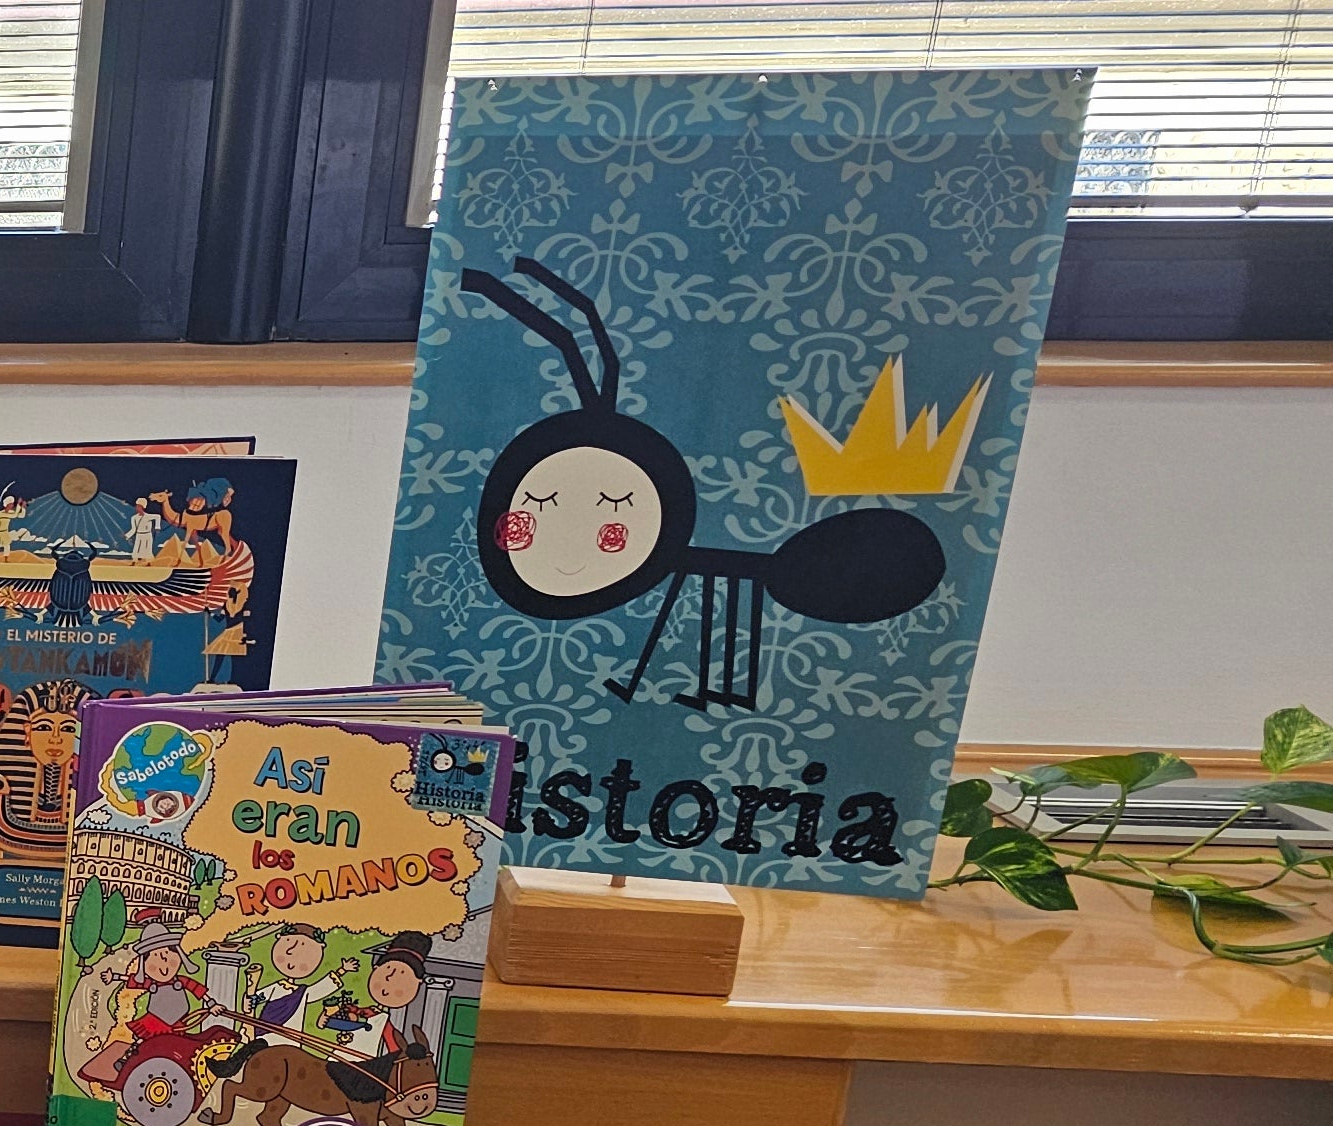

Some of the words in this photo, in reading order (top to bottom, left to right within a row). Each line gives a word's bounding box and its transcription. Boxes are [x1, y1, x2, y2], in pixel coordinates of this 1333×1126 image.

[6, 629, 21, 641] EL
[25, 629, 94, 645] MISTERIO
[97, 632, 117, 645] DE
[115, 740, 198, 785] Sabelotodo
[253, 746, 330, 796] Así
[232, 799, 361, 848] eran
[505, 741, 904, 866] istoria
[252, 839, 295, 872] los
[236, 847, 458, 916] ROMANOS
